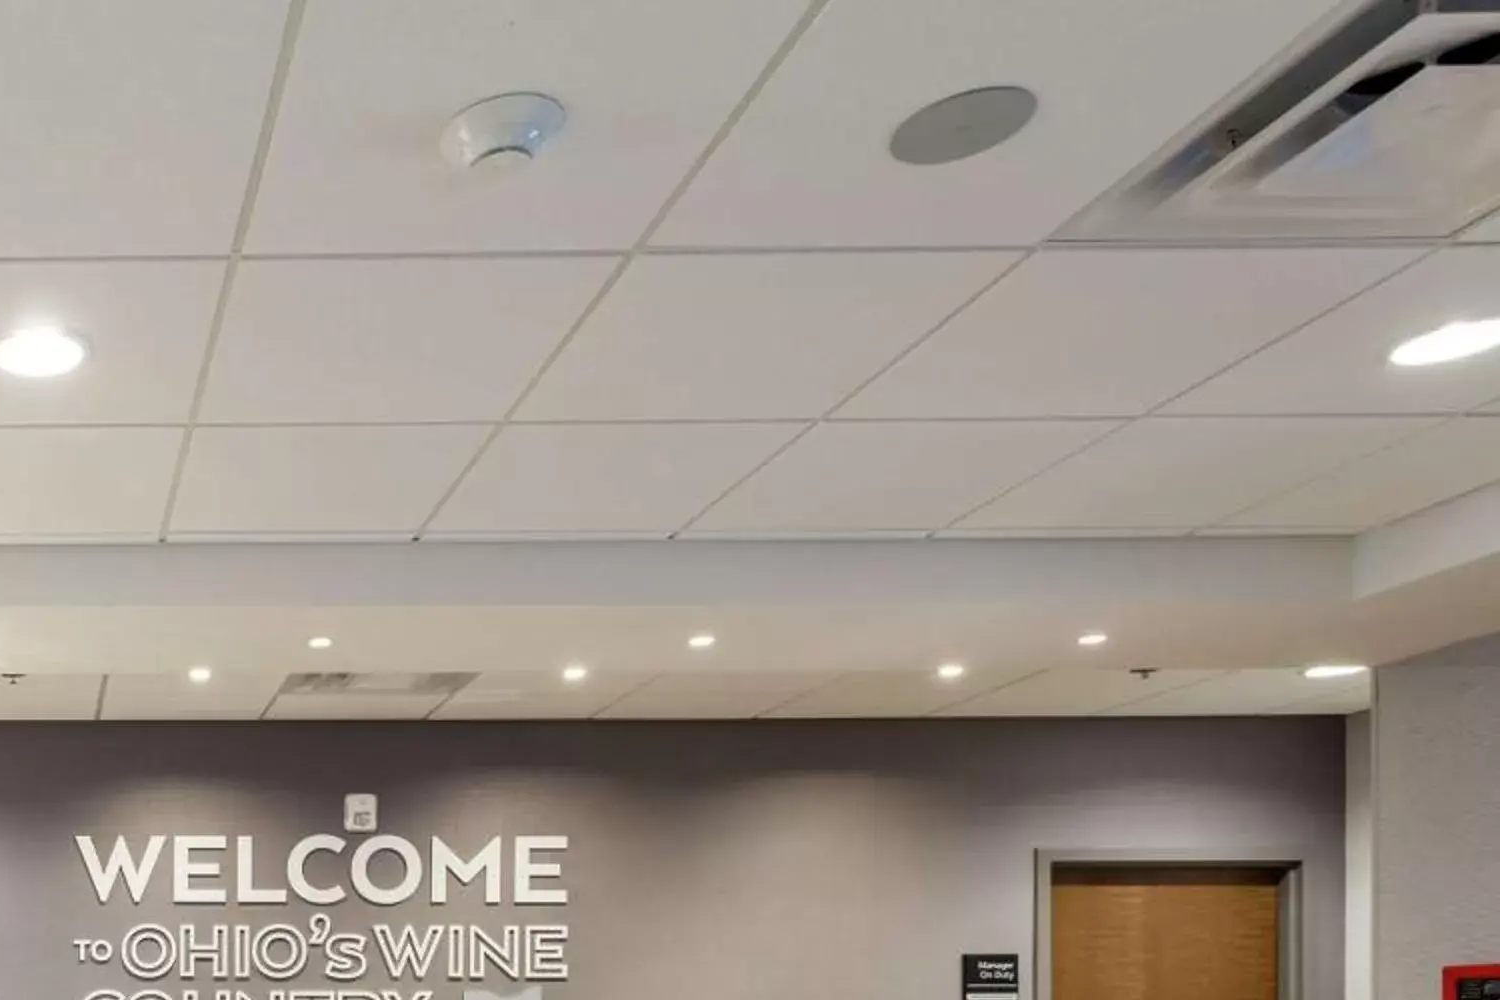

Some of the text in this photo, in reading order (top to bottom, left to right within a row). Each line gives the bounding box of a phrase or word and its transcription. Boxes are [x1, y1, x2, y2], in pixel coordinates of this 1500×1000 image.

[75, 834, 568, 905] WELCOME
[74, 938, 113, 962] TO
[373, 924, 568, 980] WINE
